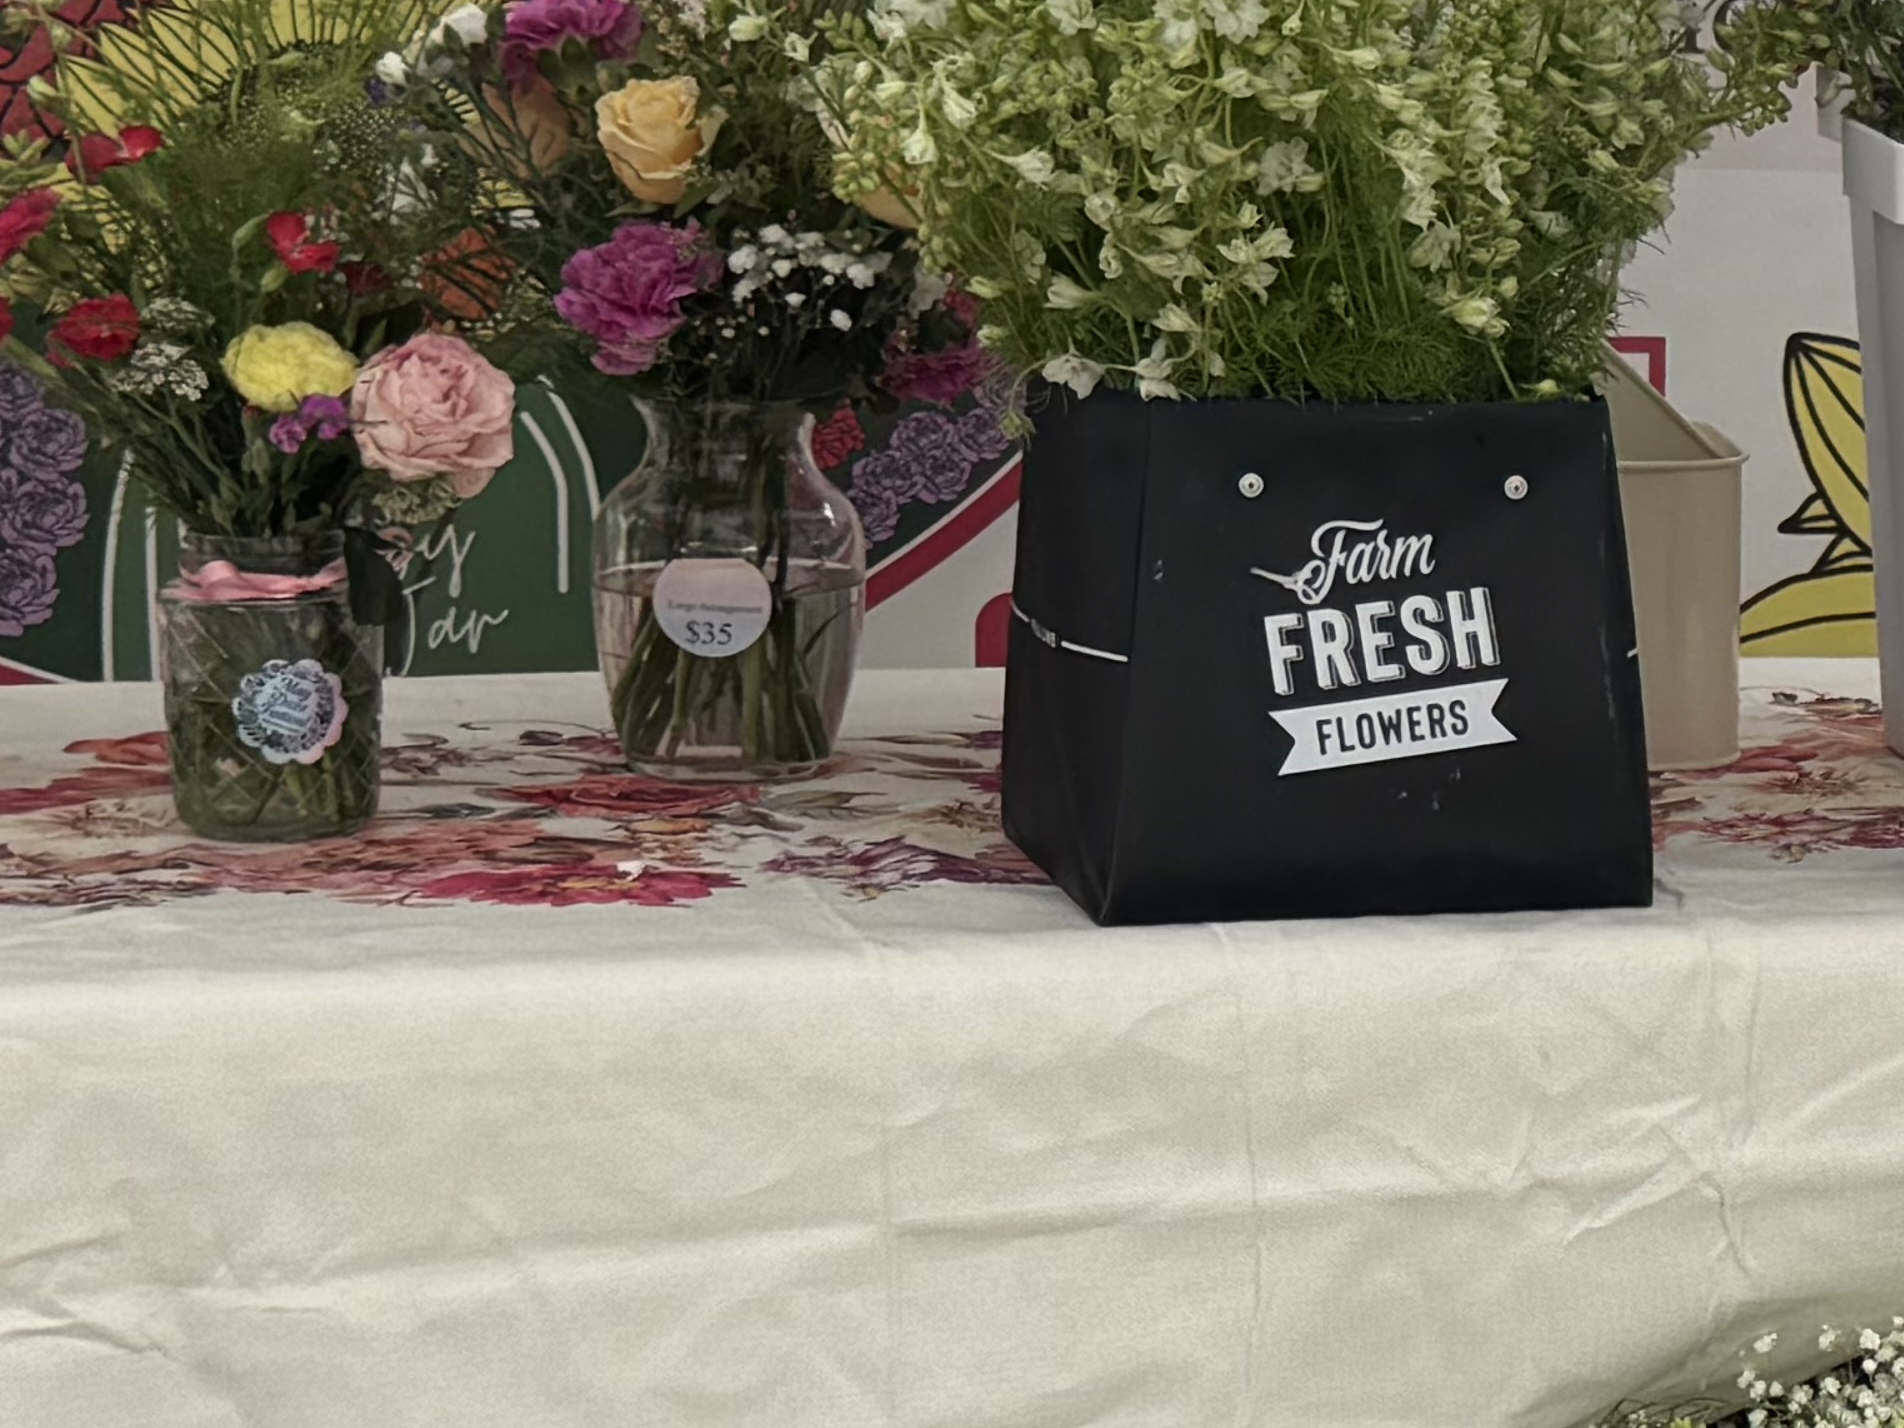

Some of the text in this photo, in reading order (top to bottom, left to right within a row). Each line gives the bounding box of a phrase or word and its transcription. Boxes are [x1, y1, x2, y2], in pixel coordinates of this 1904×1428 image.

[1297, 517, 1437, 606] Farm
[685, 619, 733, 646] $35
[1263, 585, 1501, 697] FRESH
[1315, 698, 1470, 756] FLOWERS
